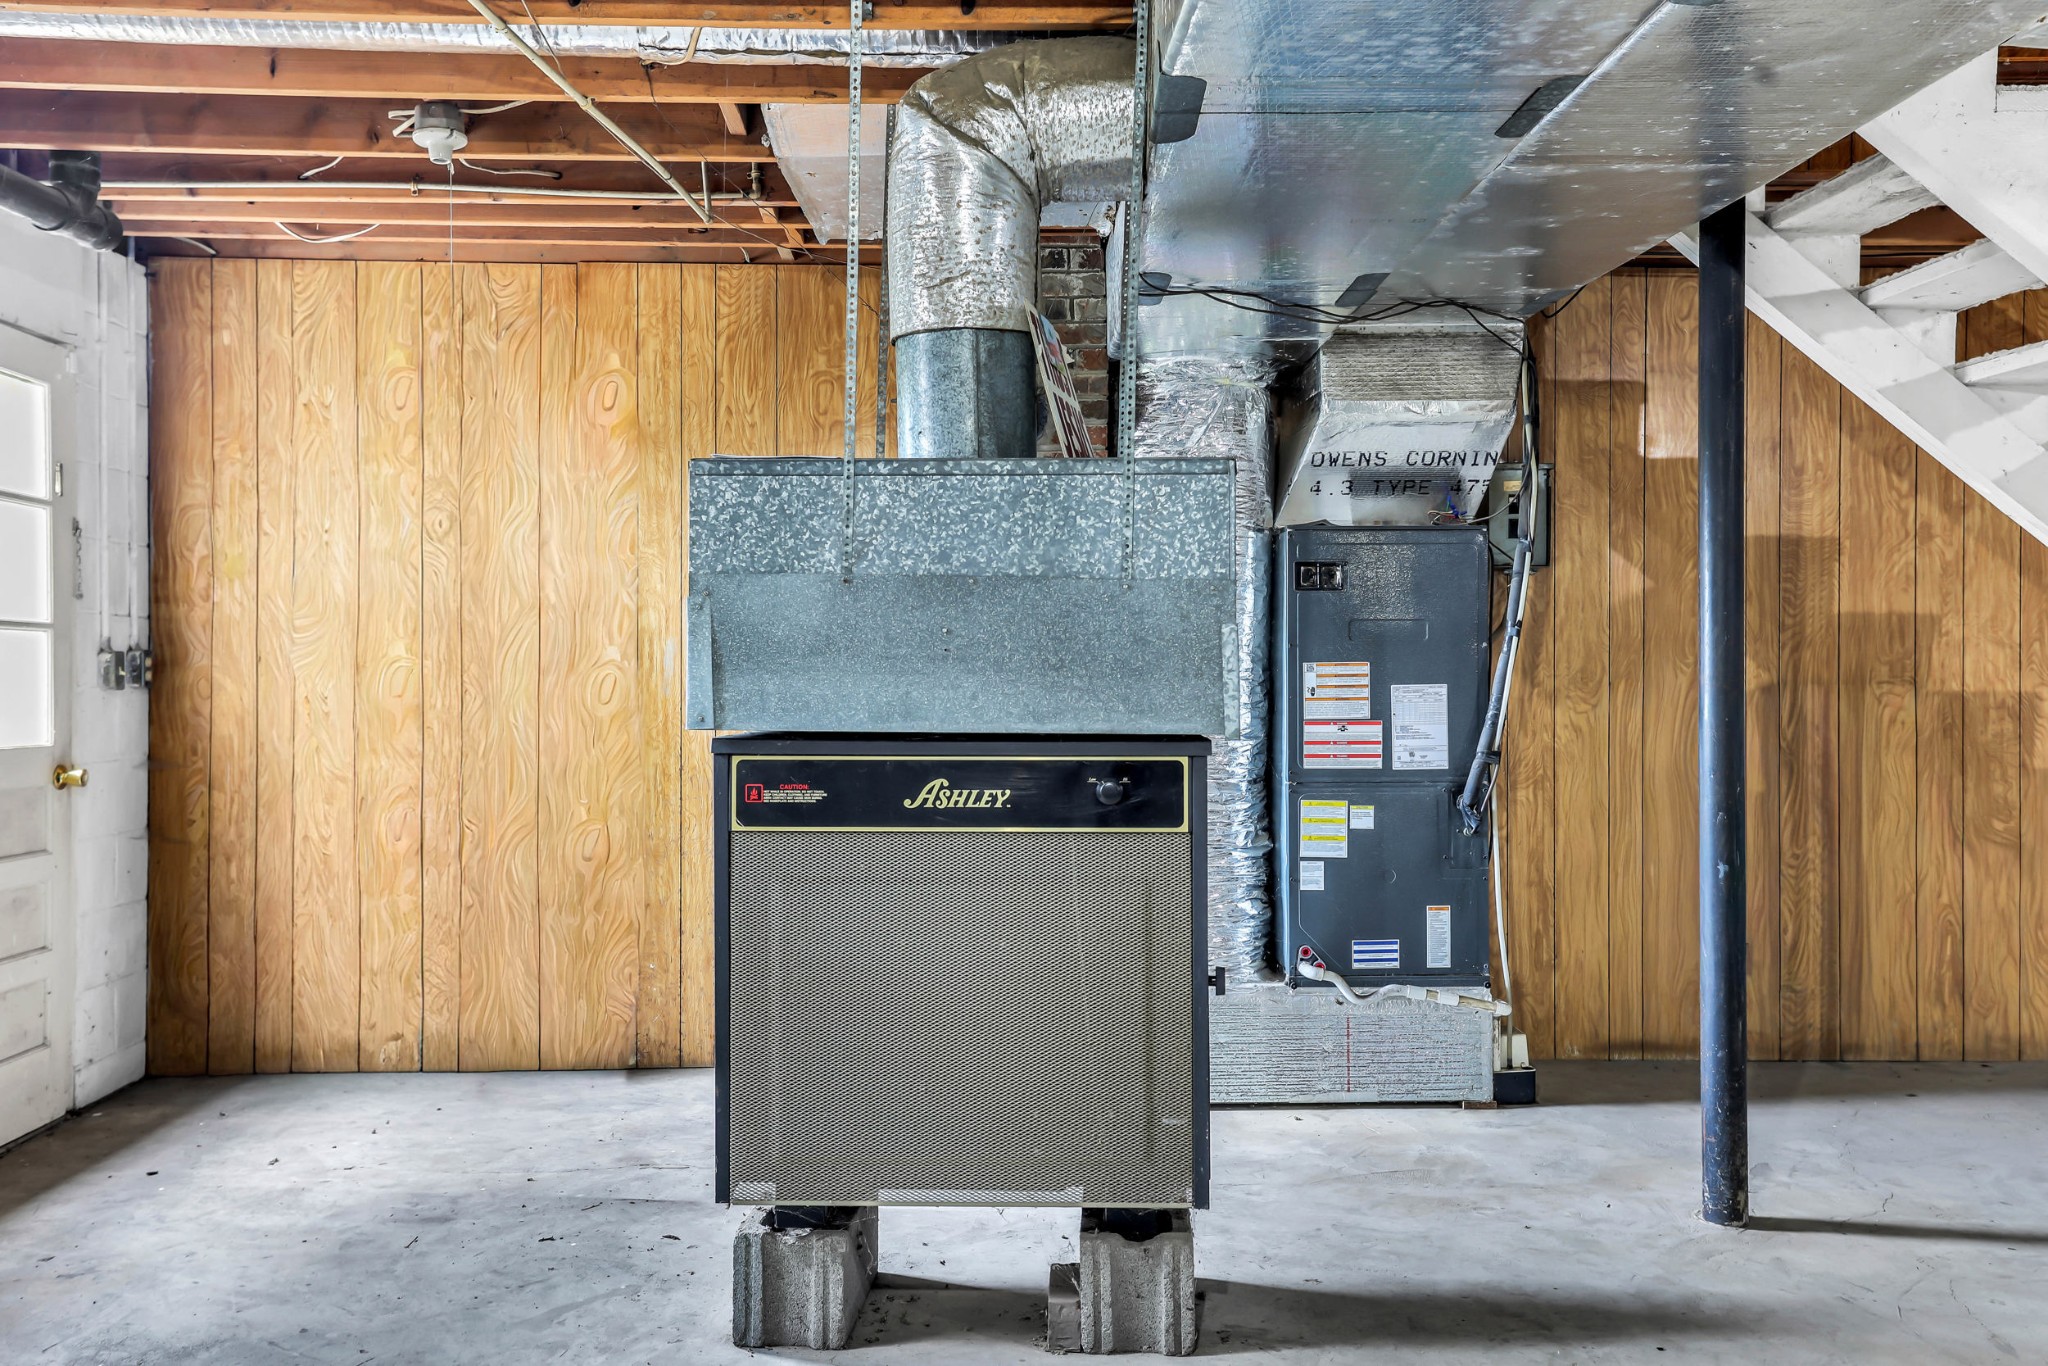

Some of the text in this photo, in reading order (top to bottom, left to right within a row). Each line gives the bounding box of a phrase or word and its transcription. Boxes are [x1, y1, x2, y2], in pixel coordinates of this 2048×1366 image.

[1310, 450, 1499, 468] OWENS CORNIN
[1310, 480, 1353, 496] 4.3
[1373, 479, 1432, 496] TYPE
